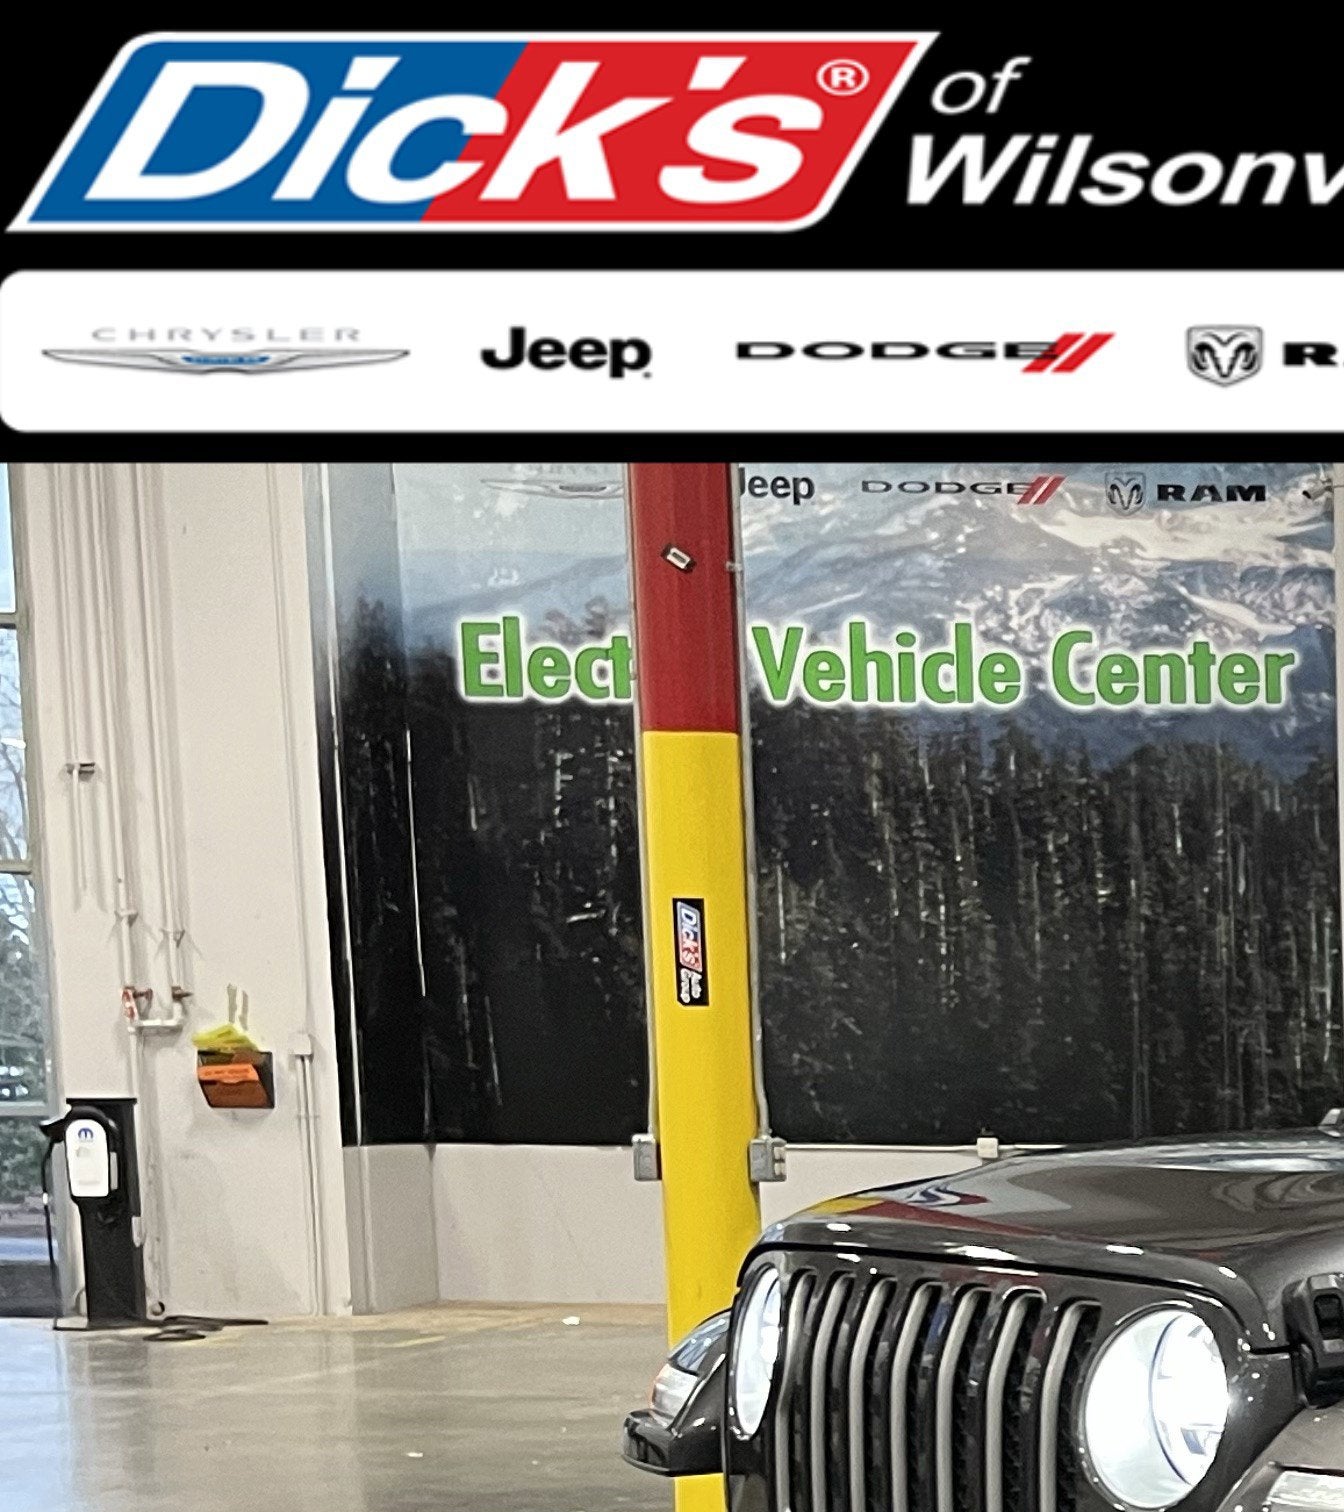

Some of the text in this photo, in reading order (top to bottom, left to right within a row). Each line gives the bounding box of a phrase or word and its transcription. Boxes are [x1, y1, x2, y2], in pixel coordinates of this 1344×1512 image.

[861, 479, 1033, 495] DODGE
[1156, 484, 1267, 502] RAM
[461, 616, 1296, 705] Elect Vehicle Center
